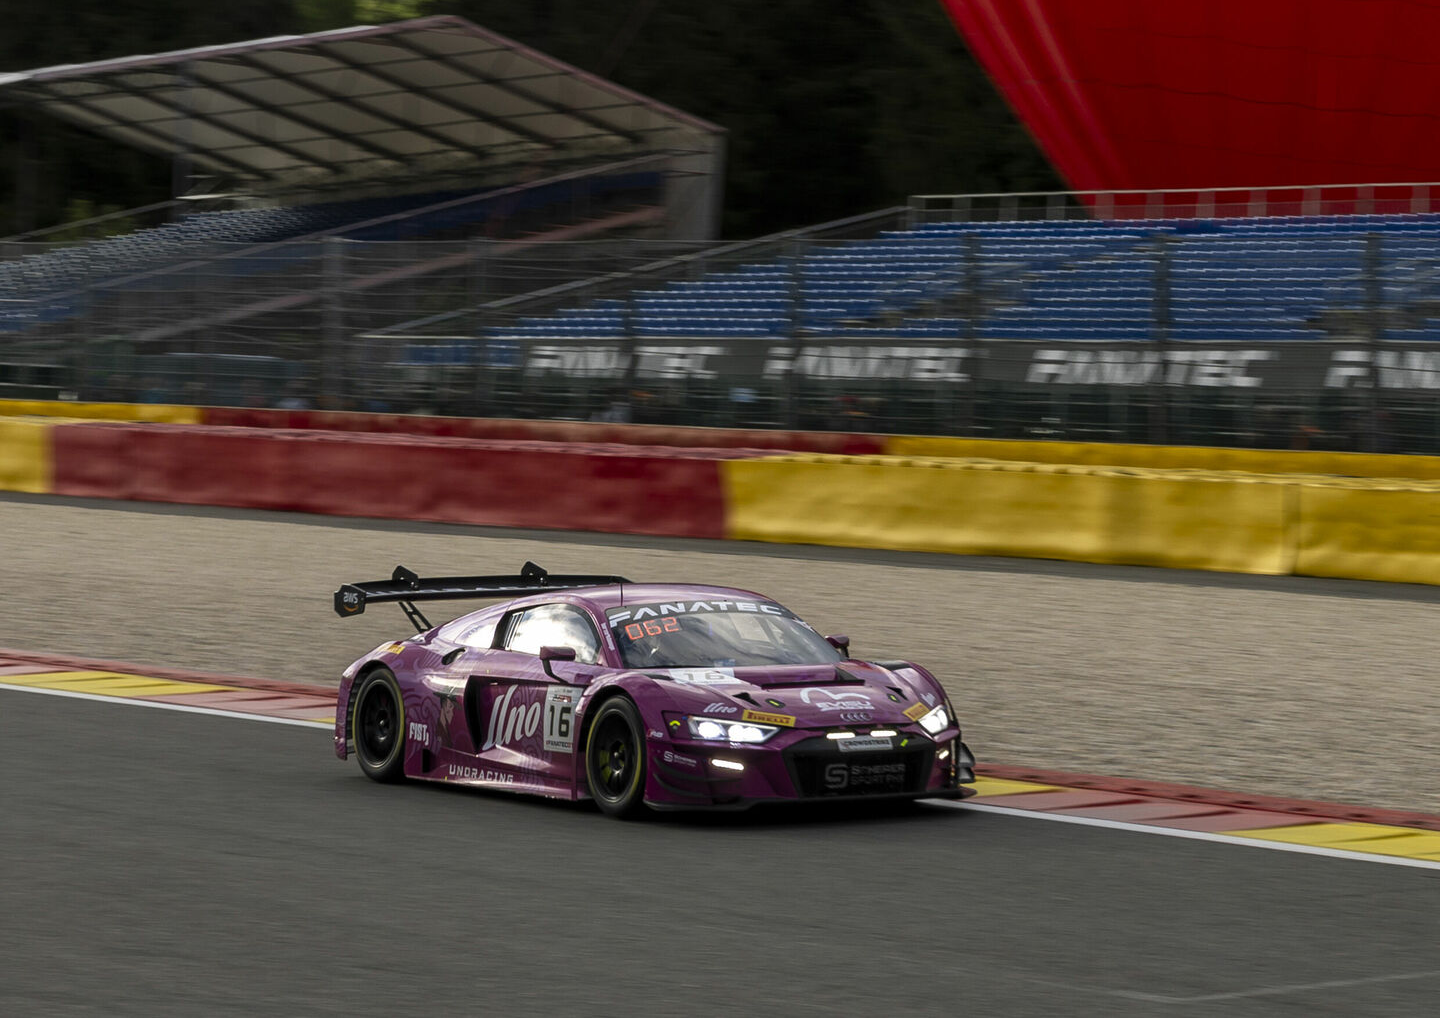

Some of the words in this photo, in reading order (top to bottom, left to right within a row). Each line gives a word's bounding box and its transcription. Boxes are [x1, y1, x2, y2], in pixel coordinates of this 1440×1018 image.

[1025, 349, 1275, 388] FANATEC
[608, 600, 783, 628] FANATEC
[624, 616, 680, 641] 062
[683, 672, 725, 681] 16
[550, 704, 572, 737] 16
[450, 764, 514, 785] UNORACING
